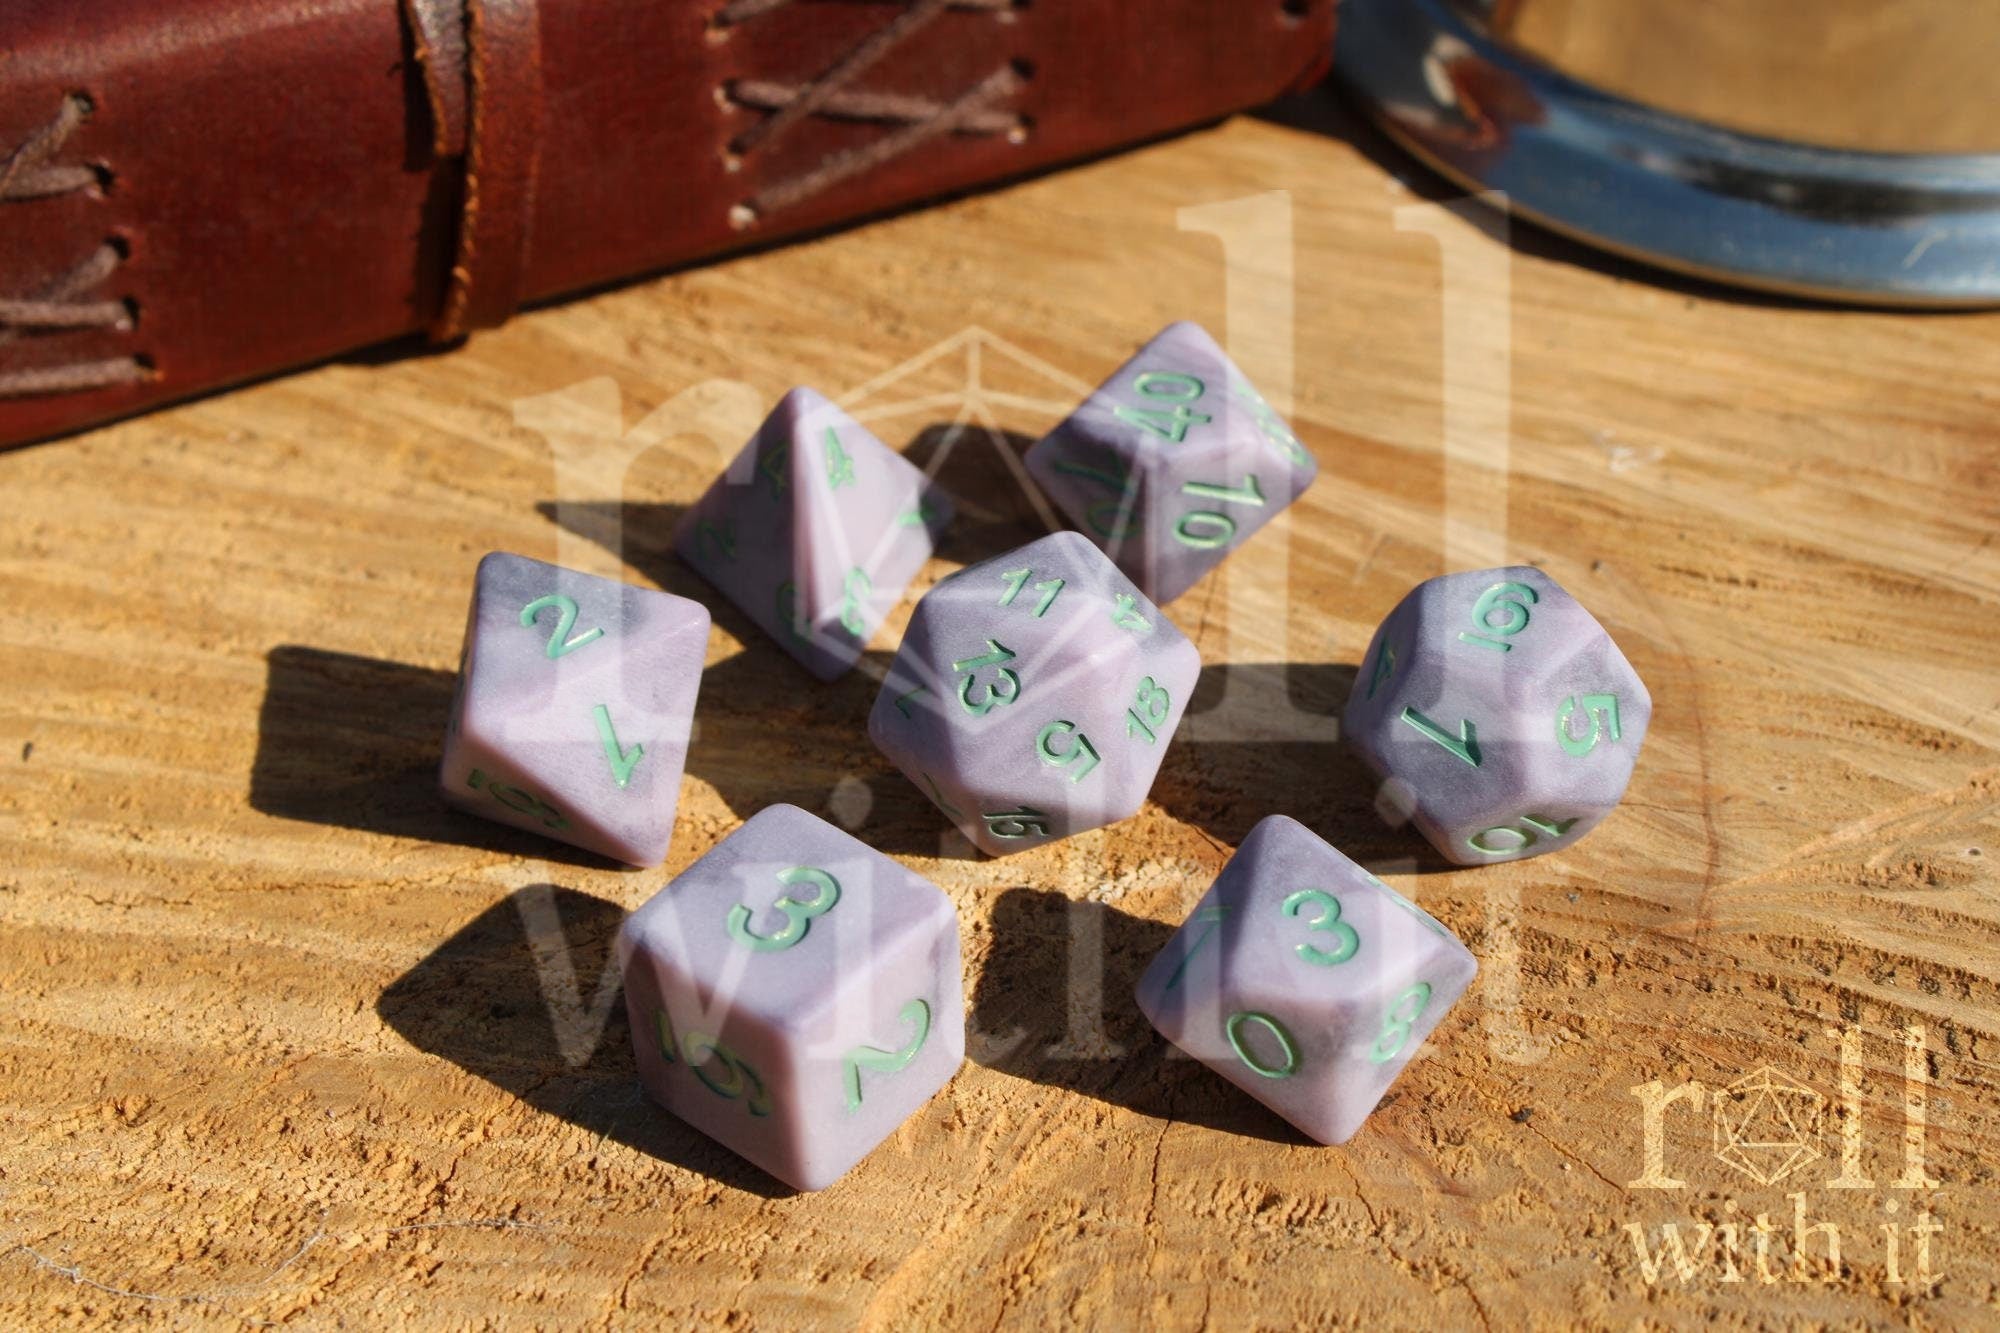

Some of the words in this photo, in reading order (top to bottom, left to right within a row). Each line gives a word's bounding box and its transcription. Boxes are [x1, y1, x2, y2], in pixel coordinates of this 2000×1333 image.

[1113, 372, 1211, 442] 40
[1172, 473, 1266, 549] 10
[519, 594, 605, 659] 2
[840, 566, 872, 636] 3
[1000, 568, 1065, 618] 11
[1112, 593, 1151, 632] 4
[953, 639, 1021, 717] 13
[1126, 675, 1170, 744] 18
[593, 703, 644, 789] 1
[1036, 719, 1101, 784] 5
[1400, 706, 1483, 768] 1
[1556, 693, 1622, 758] 5
[982, 806, 1049, 839] 15
[1466, 813, 1582, 855] 10
[728, 866, 842, 953] 3
[1281, 889, 1360, 966] 3
[843, 998, 931, 1114] 2
[1226, 1011, 1298, 1079] 0
[1369, 982, 1432, 1064] 8
